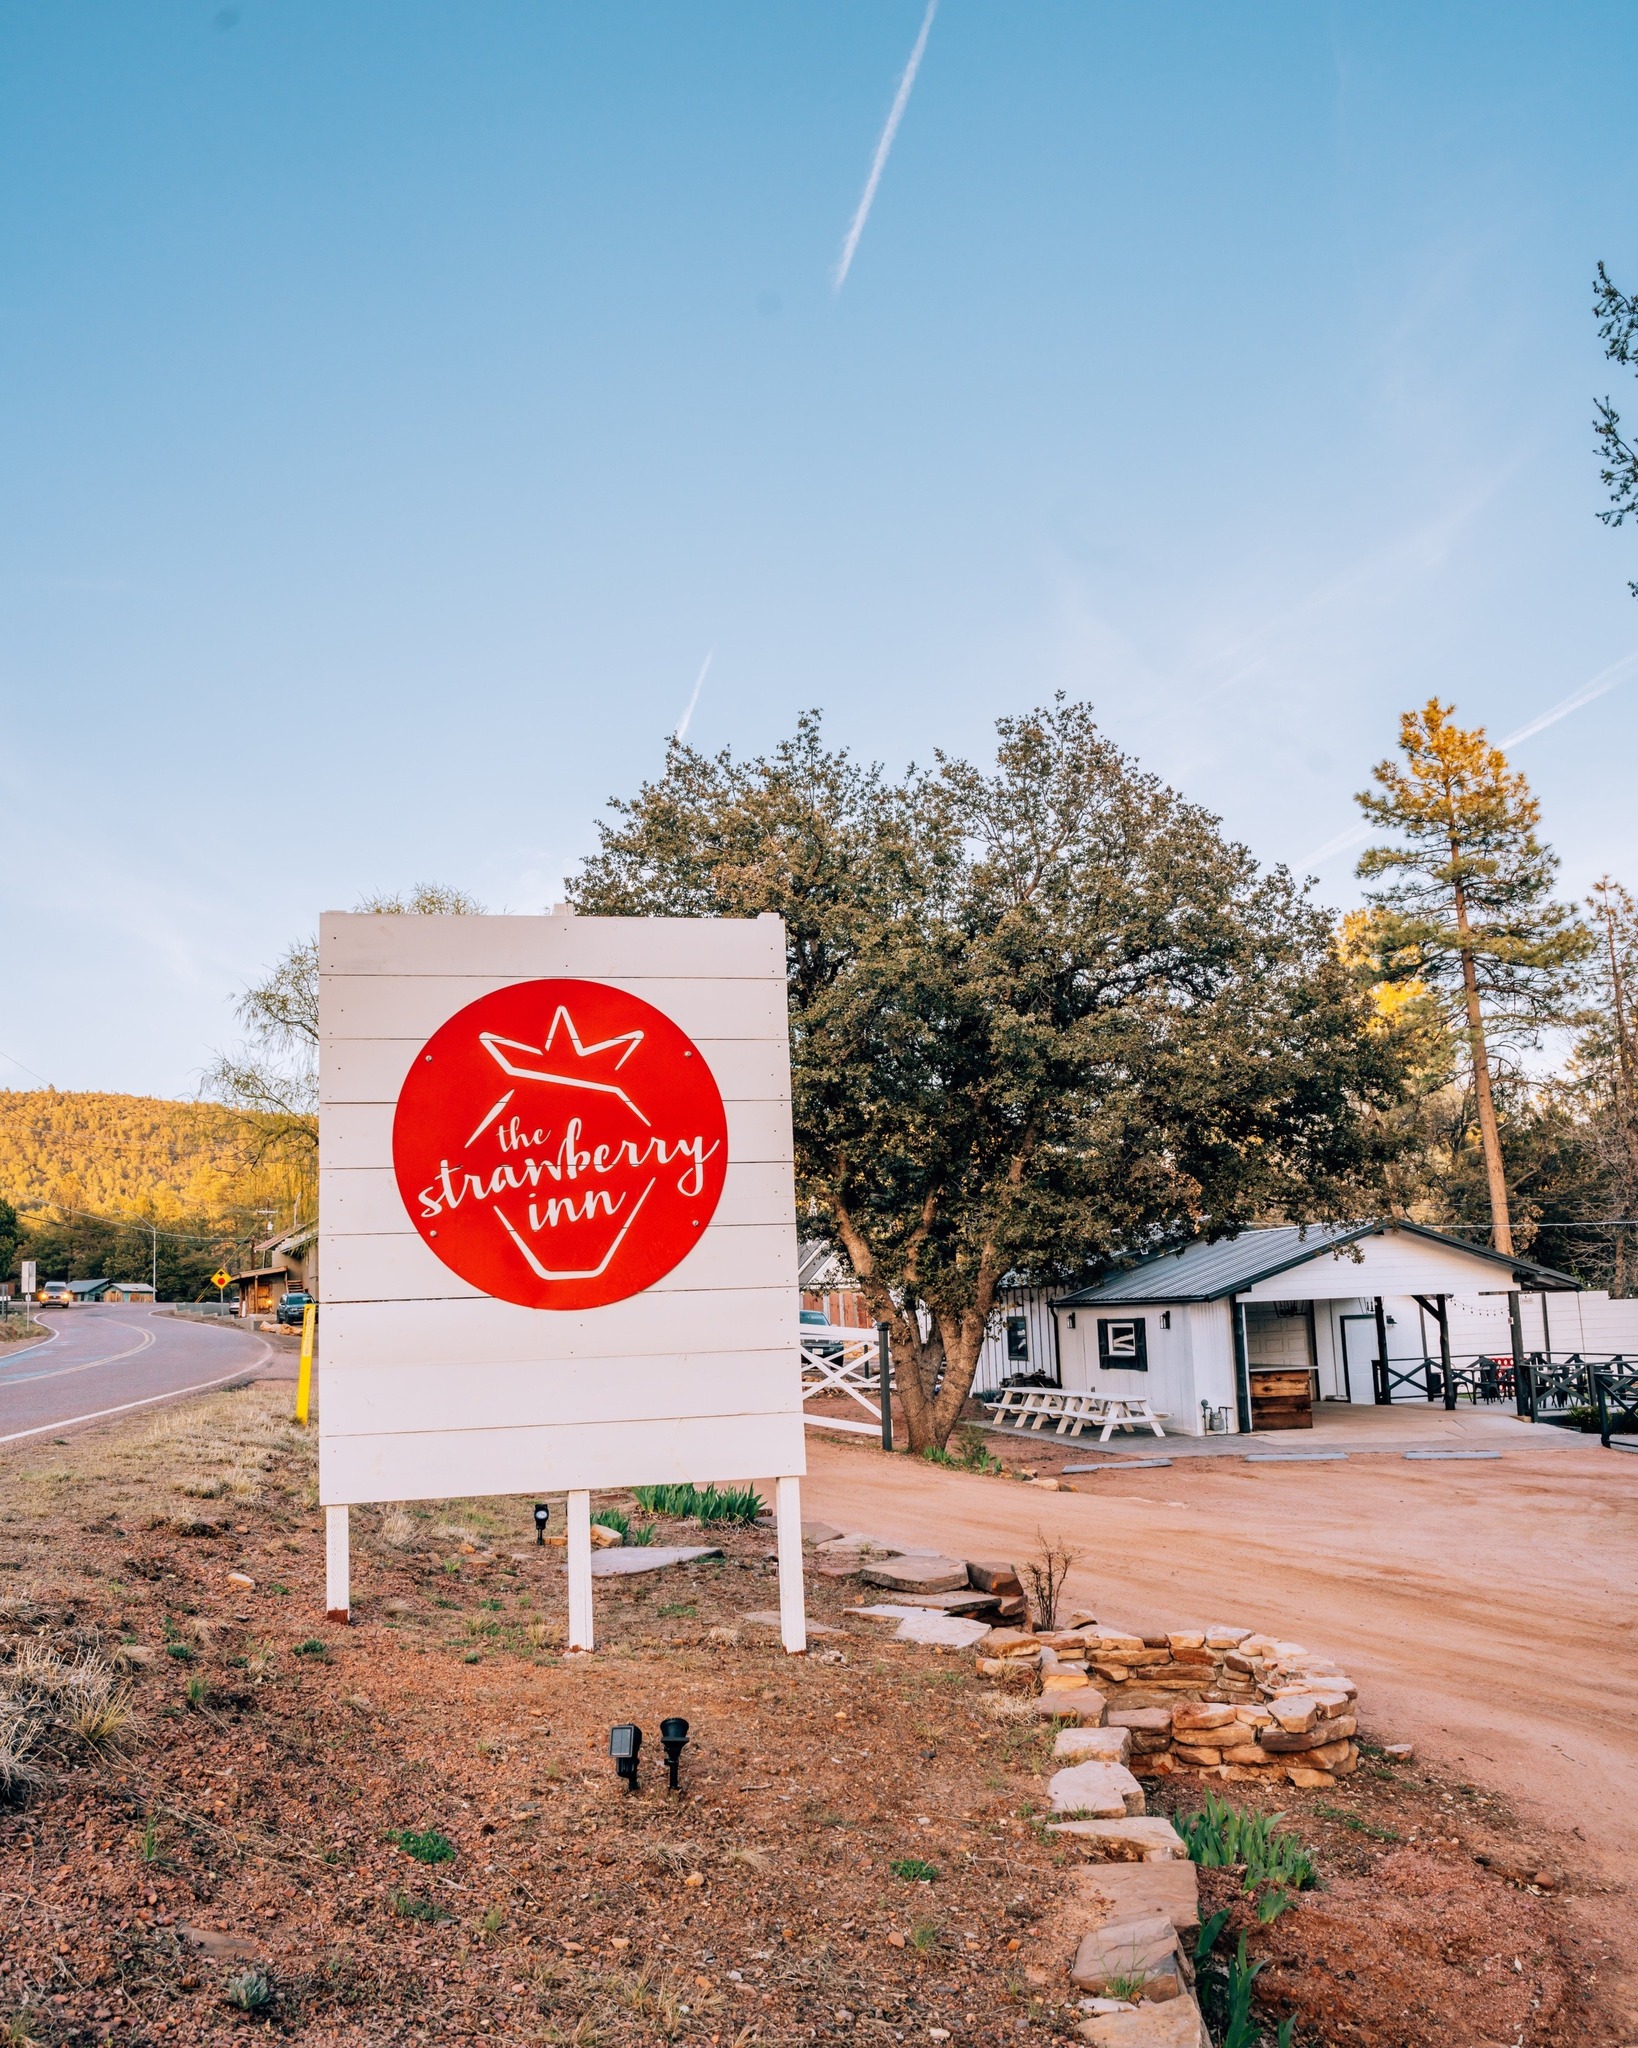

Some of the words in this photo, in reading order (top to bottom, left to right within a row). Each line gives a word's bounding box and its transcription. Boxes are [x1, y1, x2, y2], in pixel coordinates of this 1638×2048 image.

[496, 1115, 551, 1153] the
[417, 1117, 720, 1218] strawberry
[528, 1190, 627, 1233] inn
